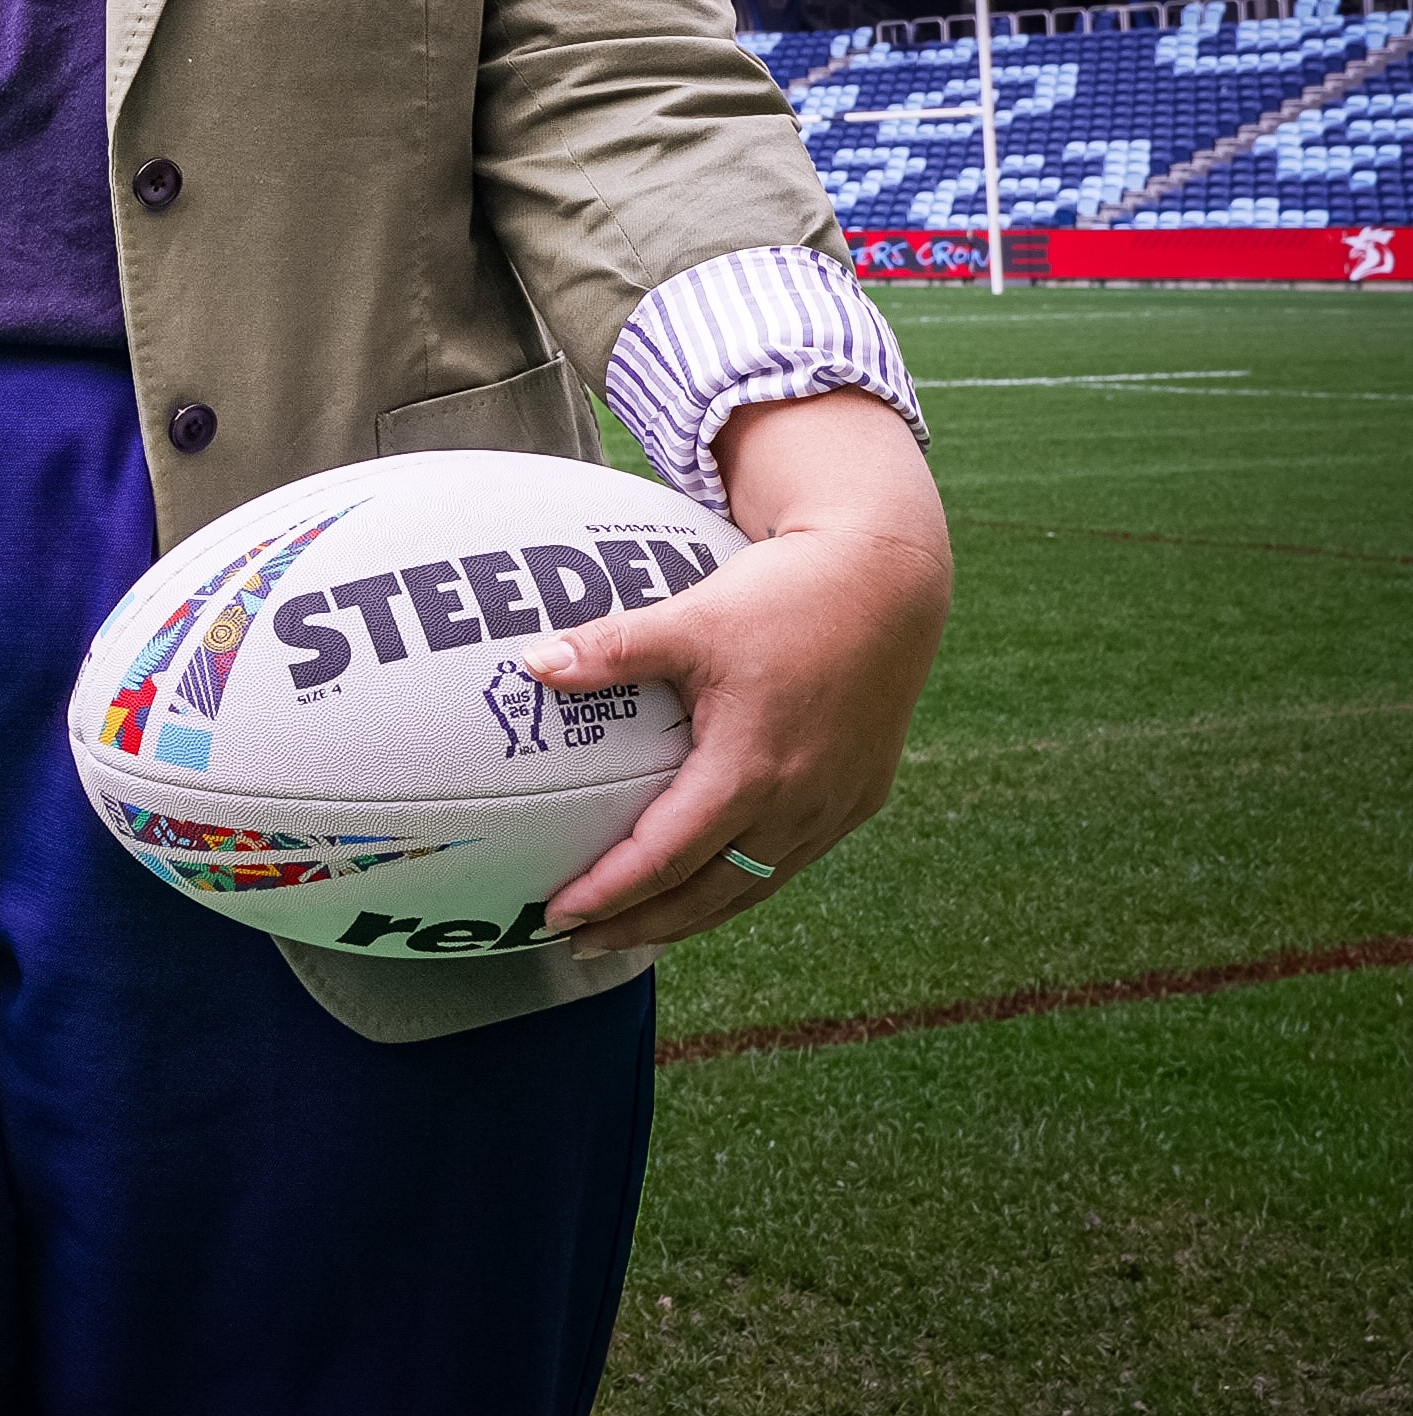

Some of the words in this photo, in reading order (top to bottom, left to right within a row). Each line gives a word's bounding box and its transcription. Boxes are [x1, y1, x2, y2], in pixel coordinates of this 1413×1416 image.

[273, 539, 719, 691] STEEDEN
[297, 688, 329, 706] SIZE
[502, 690, 531, 707] AUS
[509, 705, 530, 720] 26
[560, 699, 638, 727] WORLD
[564, 724, 606, 748] CUP
